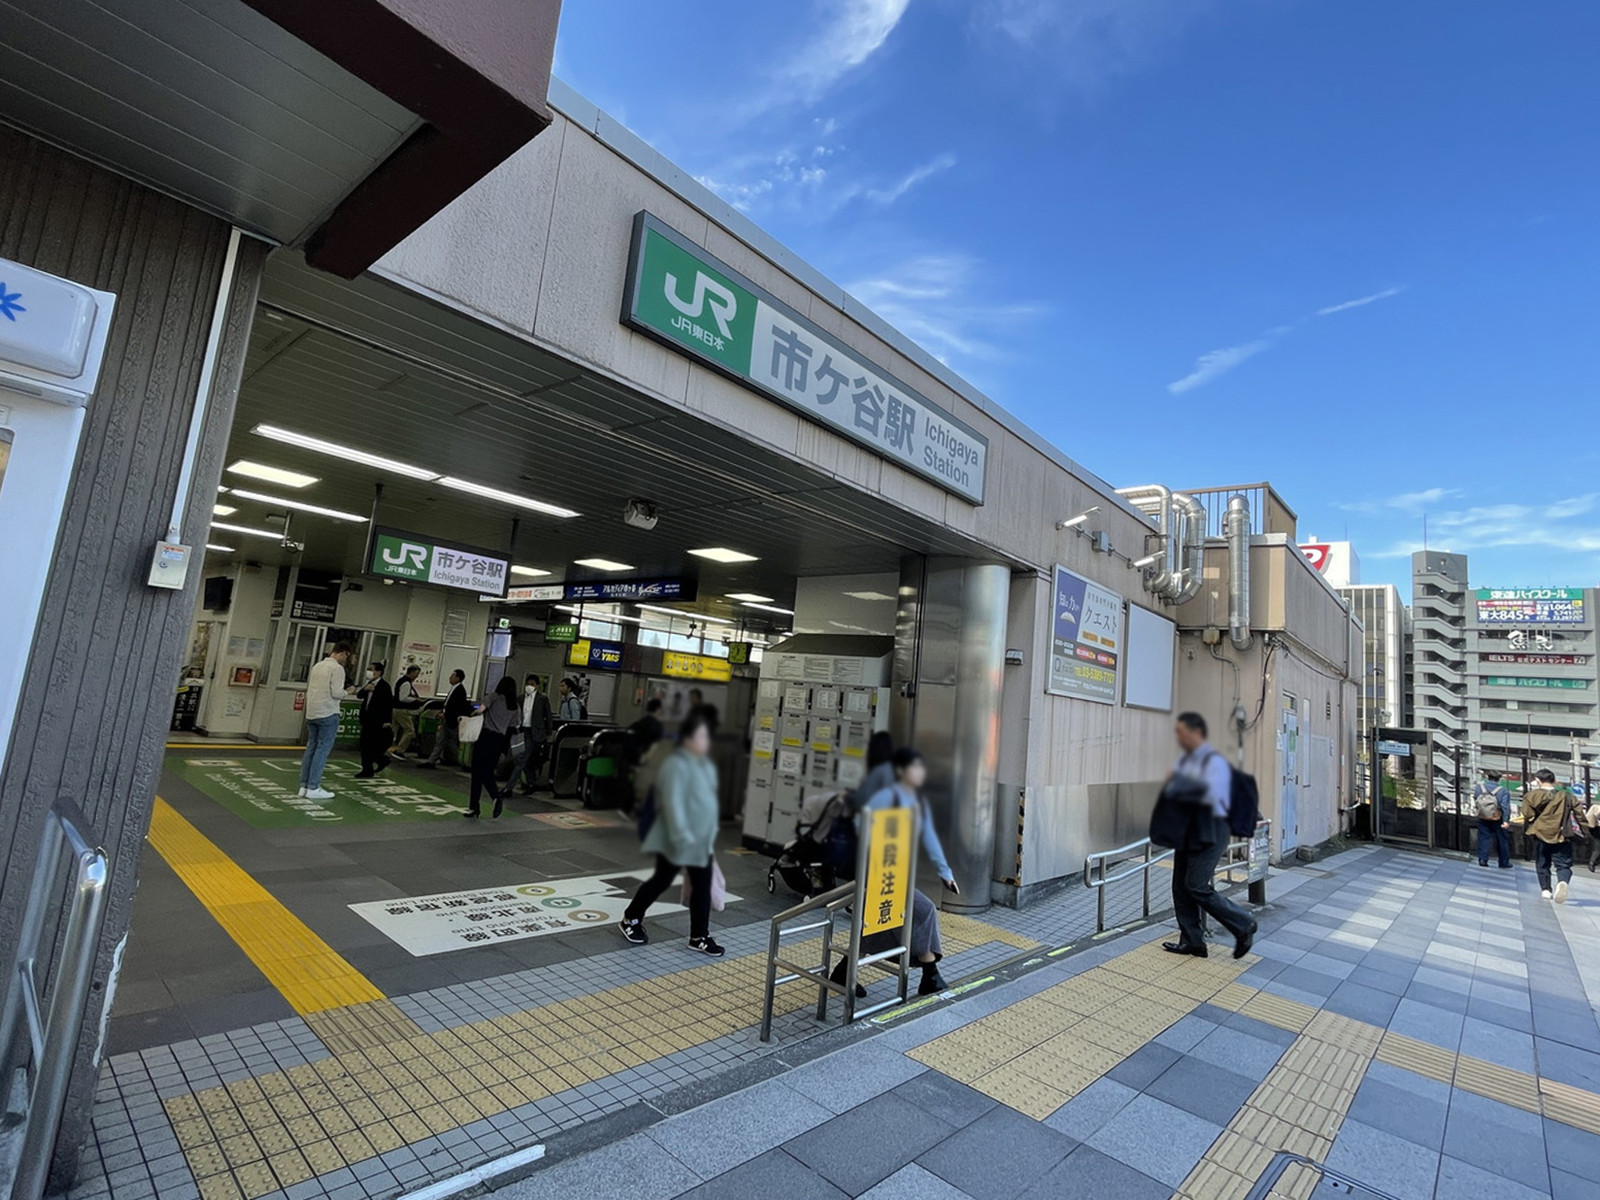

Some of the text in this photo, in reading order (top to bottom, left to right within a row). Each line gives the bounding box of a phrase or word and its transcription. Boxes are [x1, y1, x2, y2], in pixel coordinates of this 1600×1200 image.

[664, 271, 737, 340] JR
[671, 315, 725, 351] JR東日本
[925, 417, 979, 466] Ichigaya
[924, 447, 969, 487] Station
[383, 543, 427, 569] JR
[385, 566, 417, 576] JR東日本
[434, 570, 500, 590] Ichigaya Station
[1085, 606, 1118, 634] クエスト
[601, 652, 620, 663] YMS
[385, 894, 518, 915] 都営新宿線
[436, 909, 467, 917] Line
[465, 906, 543, 922] 南北線
[451, 925, 484, 934] Line
[461, 920, 571, 942] 有楽町線
